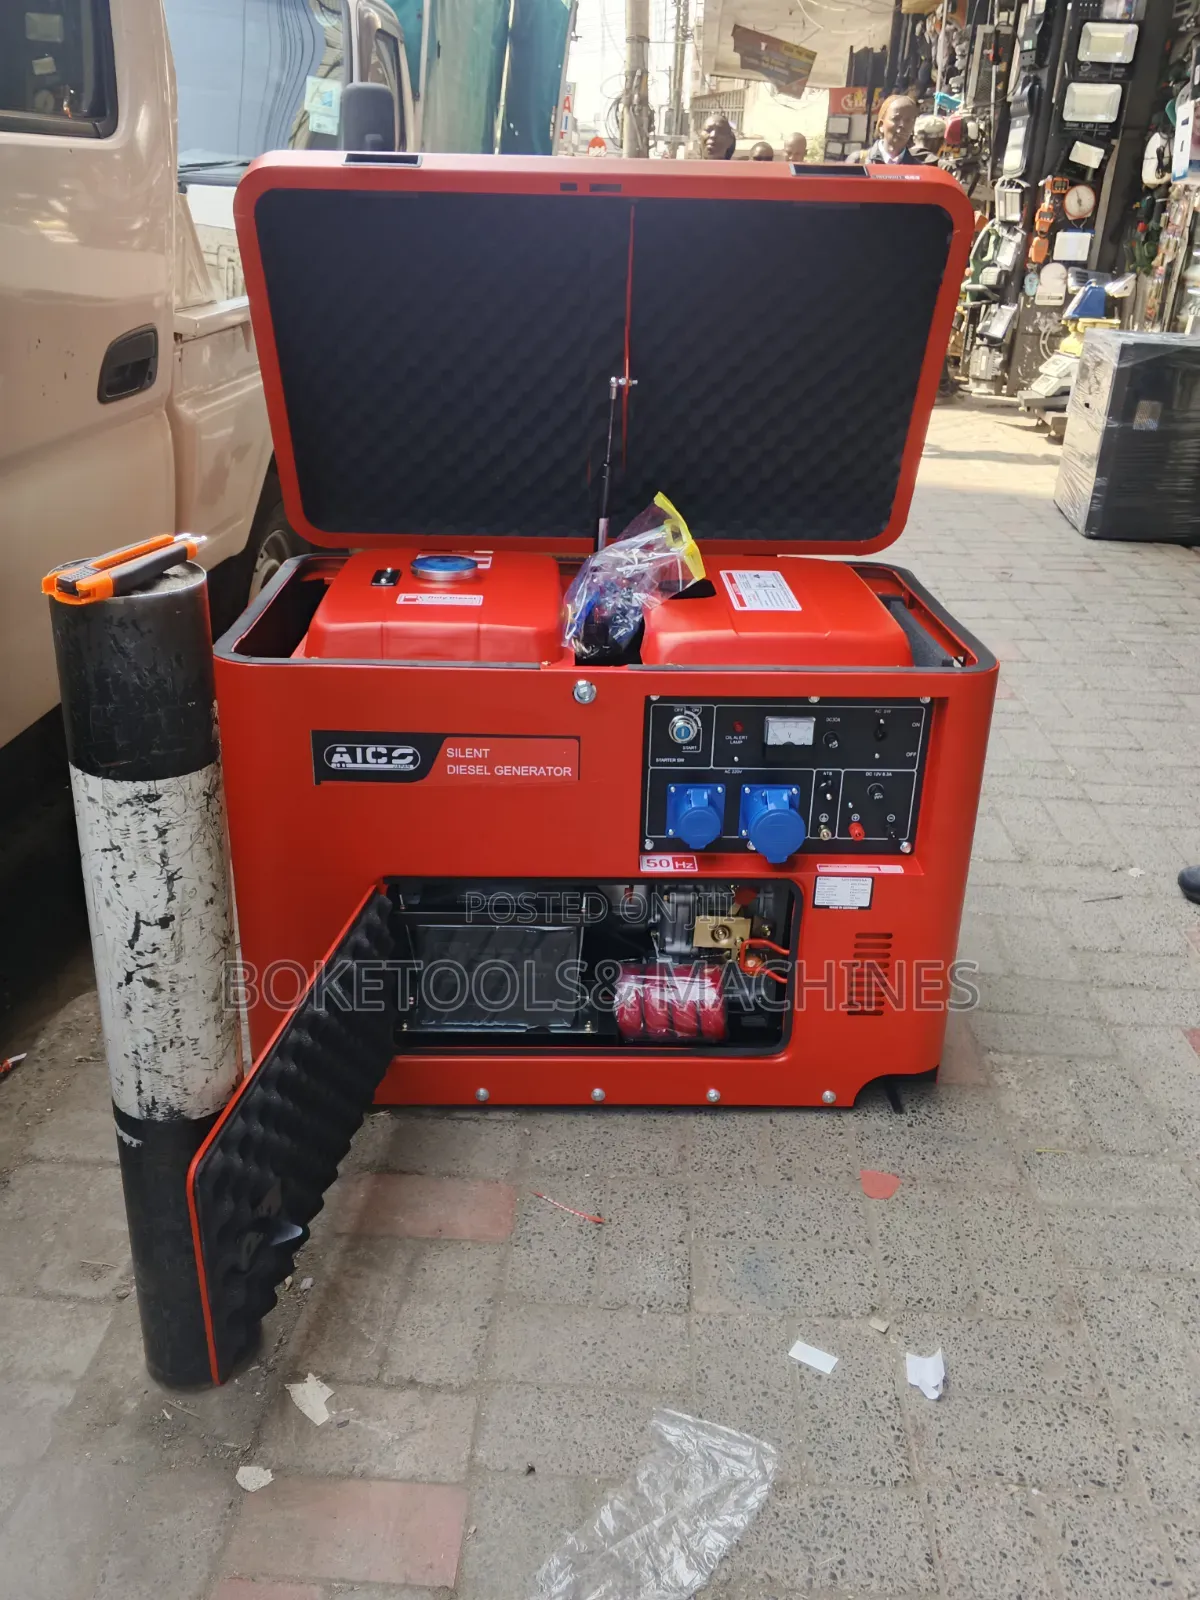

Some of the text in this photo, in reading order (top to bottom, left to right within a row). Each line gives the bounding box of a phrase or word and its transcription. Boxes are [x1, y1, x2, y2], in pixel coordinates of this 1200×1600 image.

[446, 747, 490, 759] SILENT
[446, 764, 572, 777] DIESEL GENERATOR
[646, 858, 694, 869] 50 Hz
